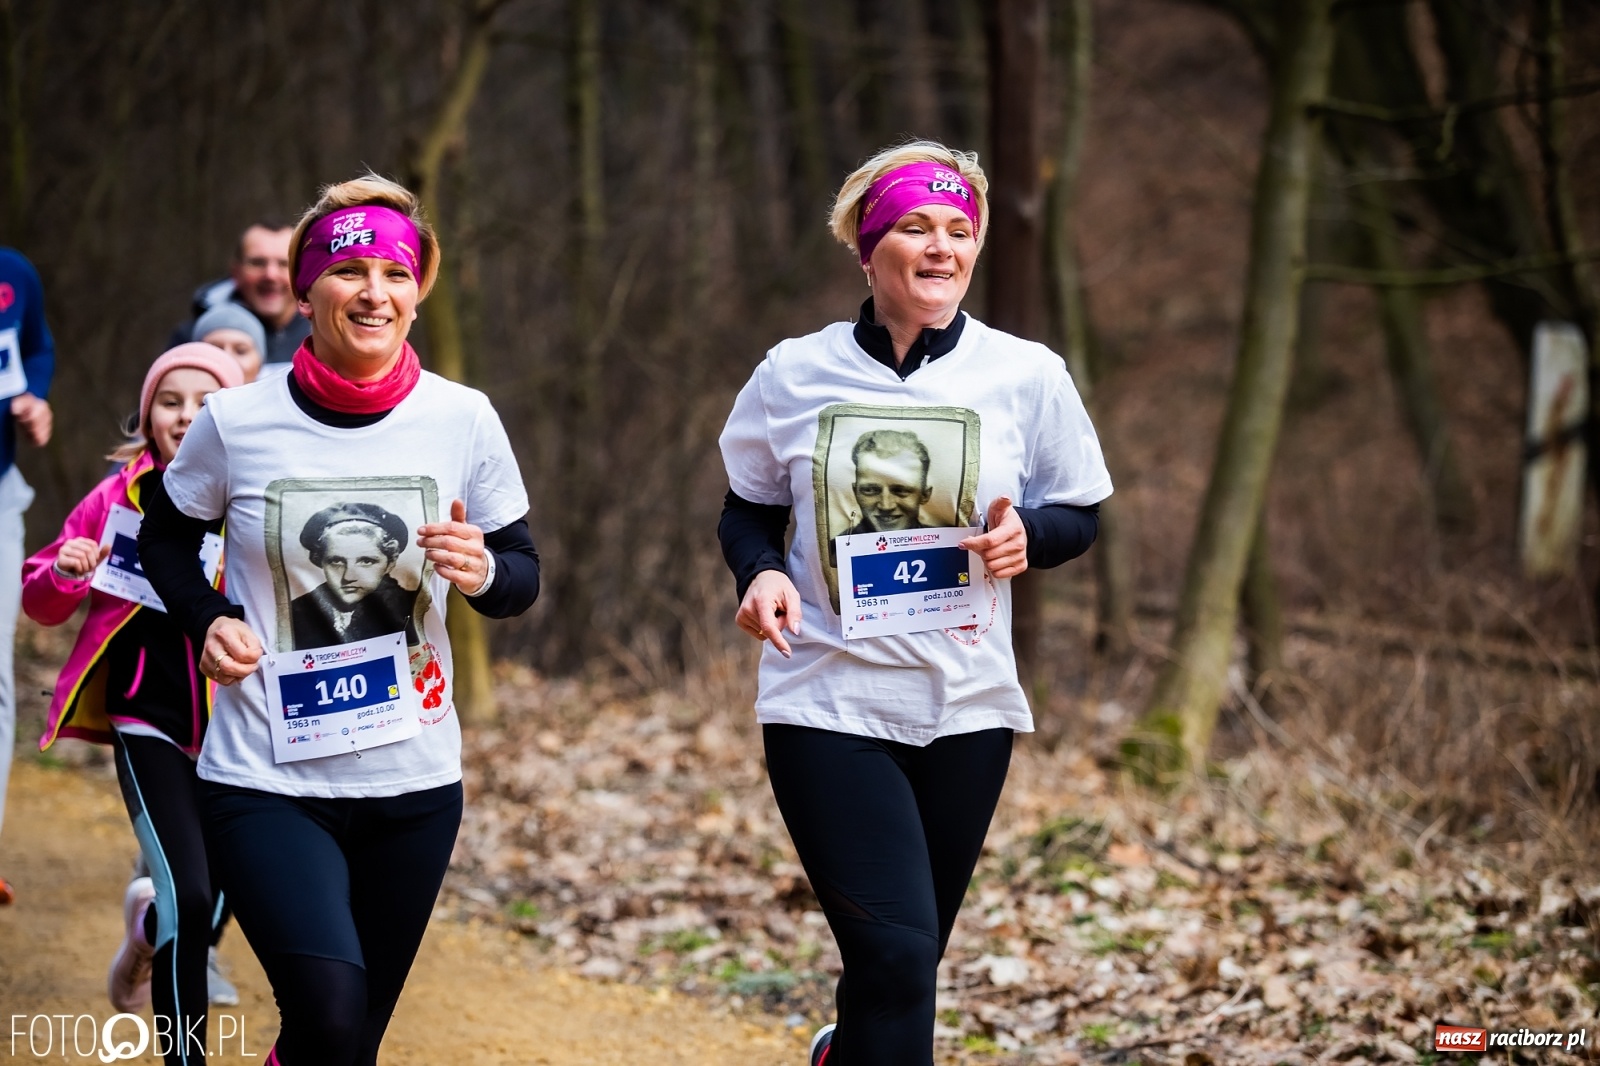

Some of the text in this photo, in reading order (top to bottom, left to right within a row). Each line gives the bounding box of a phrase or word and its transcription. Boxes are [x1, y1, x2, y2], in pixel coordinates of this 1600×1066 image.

[893, 559, 928, 584] 42
[856, 598, 889, 608] 1963 m
[923, 589, 964, 602] godz.10.00
[315, 673, 368, 706] 140
[356, 703, 395, 720] godz.10.00
[287, 719, 321, 730] 1963 m
